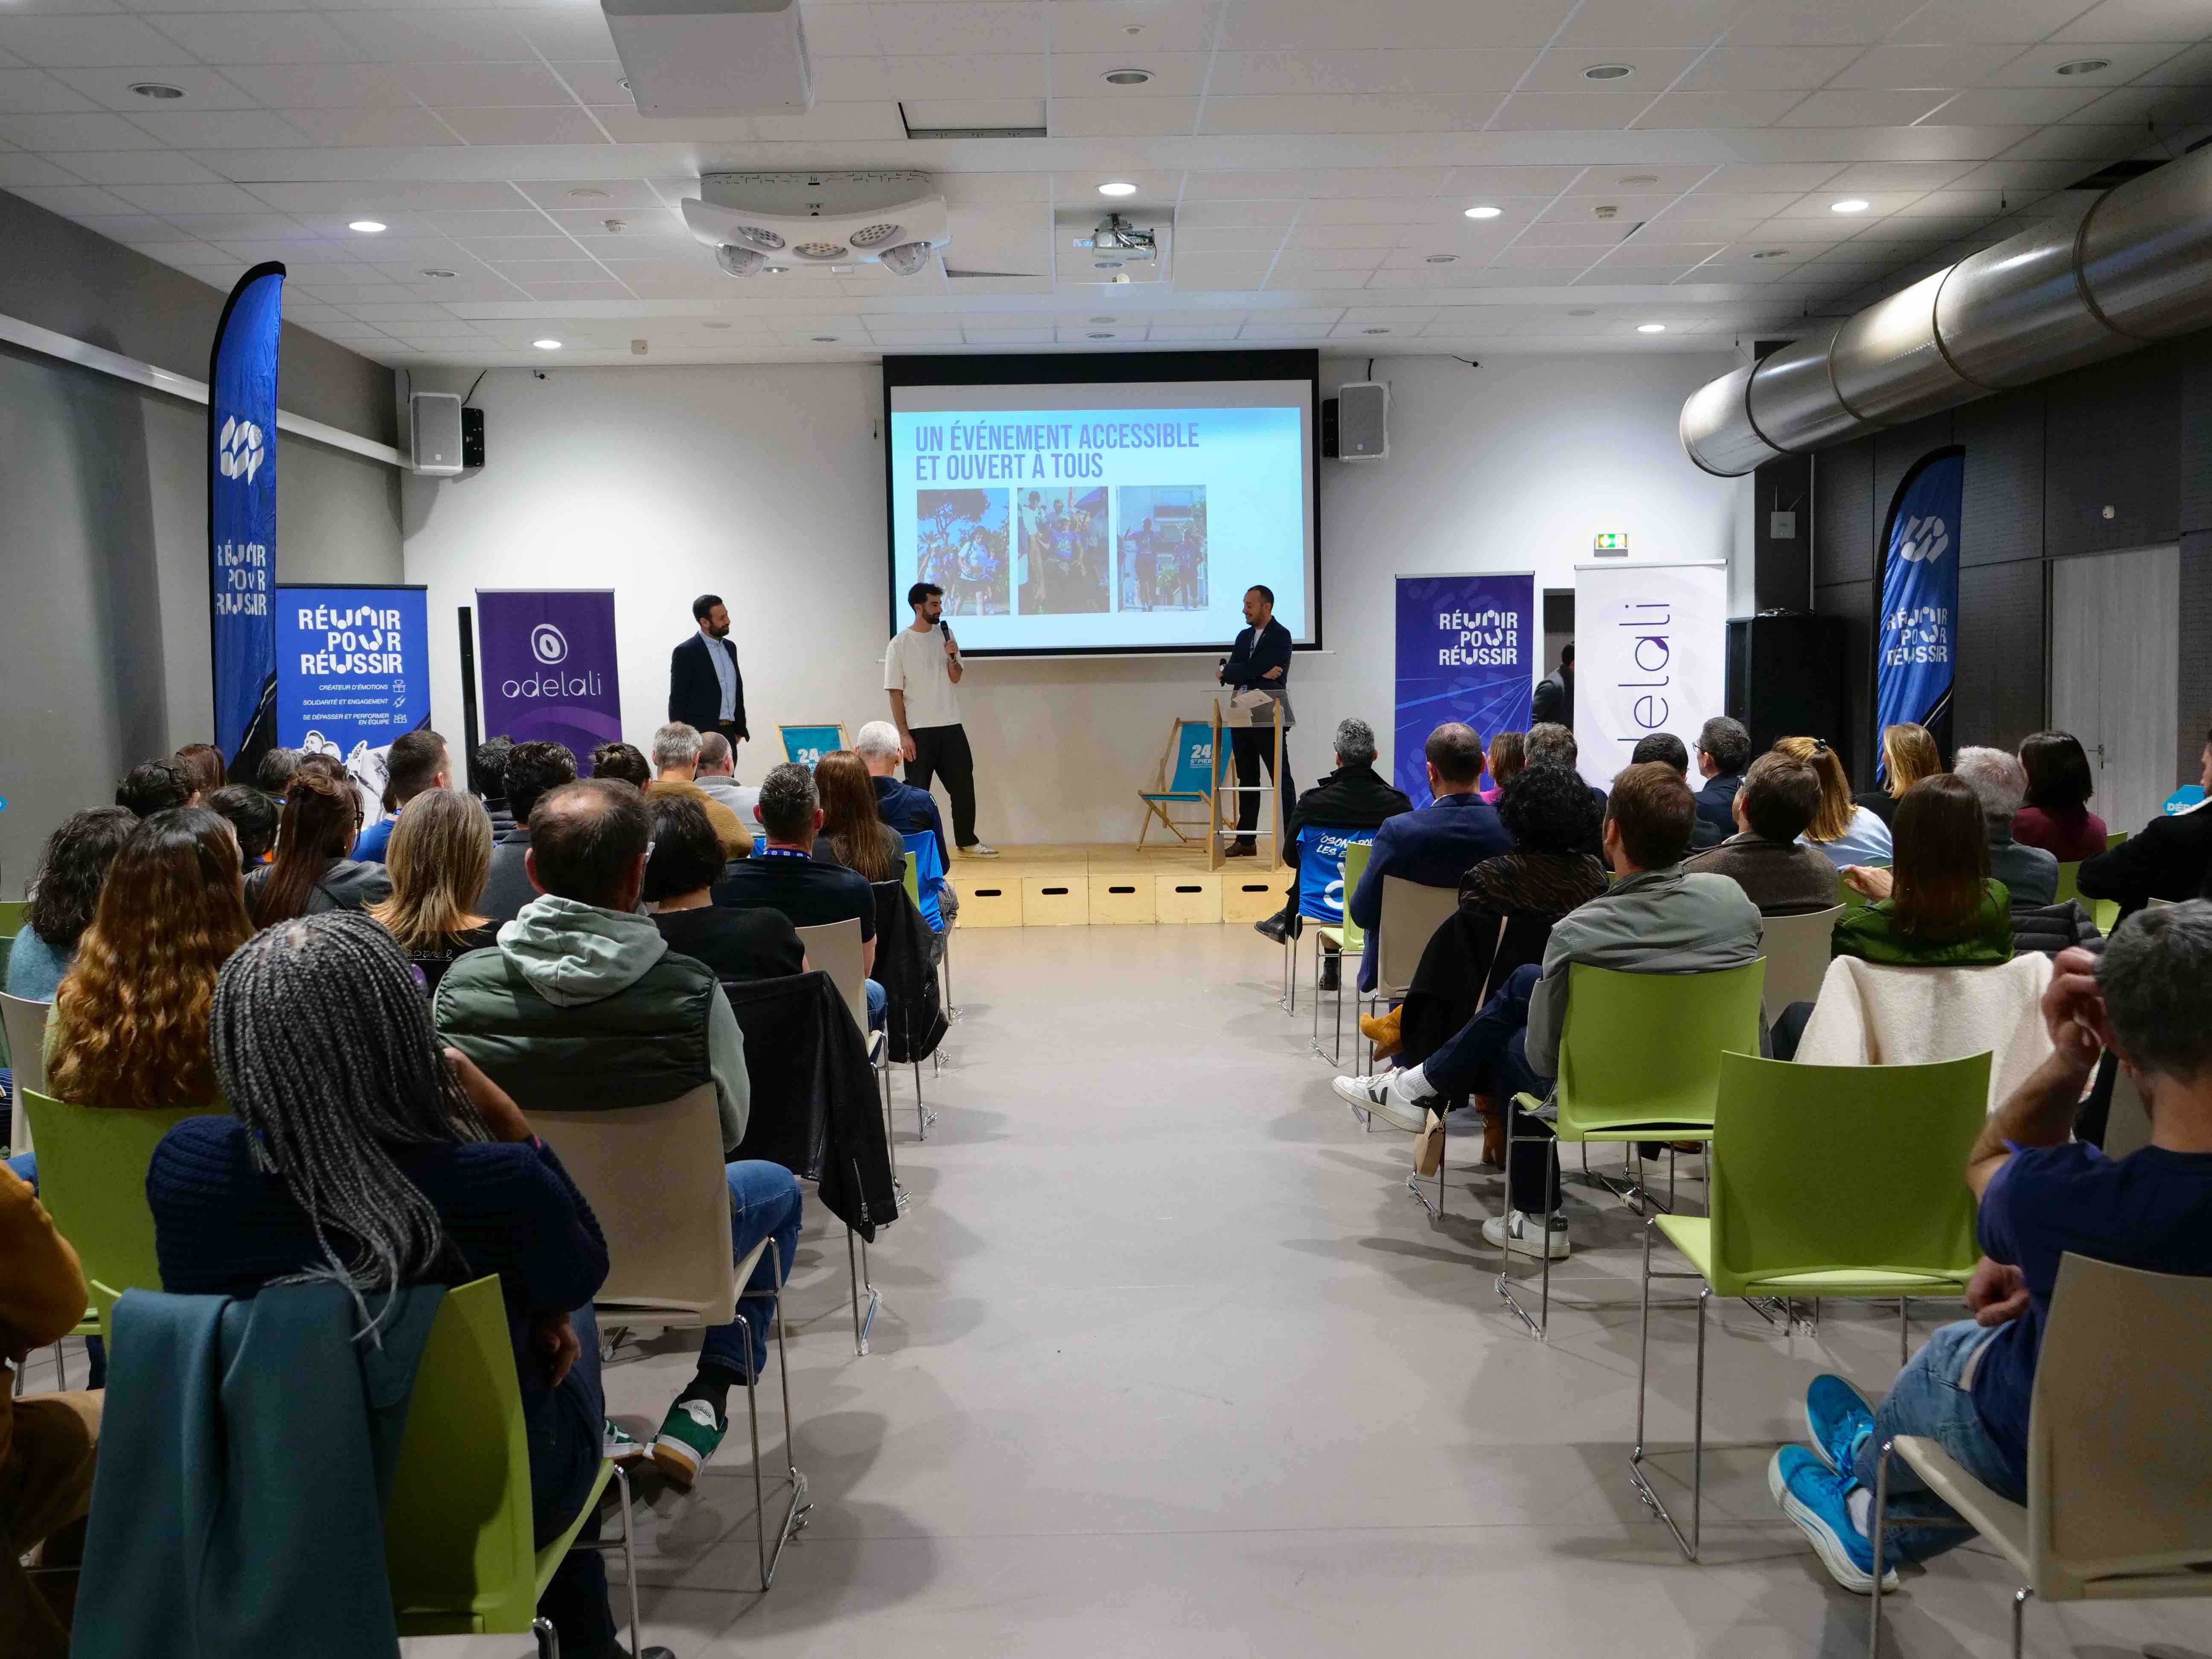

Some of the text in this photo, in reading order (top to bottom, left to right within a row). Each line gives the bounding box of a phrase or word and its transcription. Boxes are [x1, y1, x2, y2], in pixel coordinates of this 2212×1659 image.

[916, 420, 1199, 451] UN ÉVÉNEMENT ACCESSIBLE
[916, 448, 1103, 480] ET OUVERT À TOUS
[298, 604, 401, 630] RÉUNIR
[1439, 609, 1518, 630] RÉUNIR
[328, 628, 402, 652] POUR
[1461, 628, 1517, 647] POUR
[1901, 624, 1947, 646] POUR
[300, 649, 403, 675] RÉUSSIR
[1439, 645, 1517, 666] RÉUSSIR
[502, 670, 601, 698] odelali
[1617, 604, 1670, 741] elali
[797, 748, 819, 763] 24
[1316, 844, 1337, 856] LES
[693, 1404, 711, 1419] adidas
